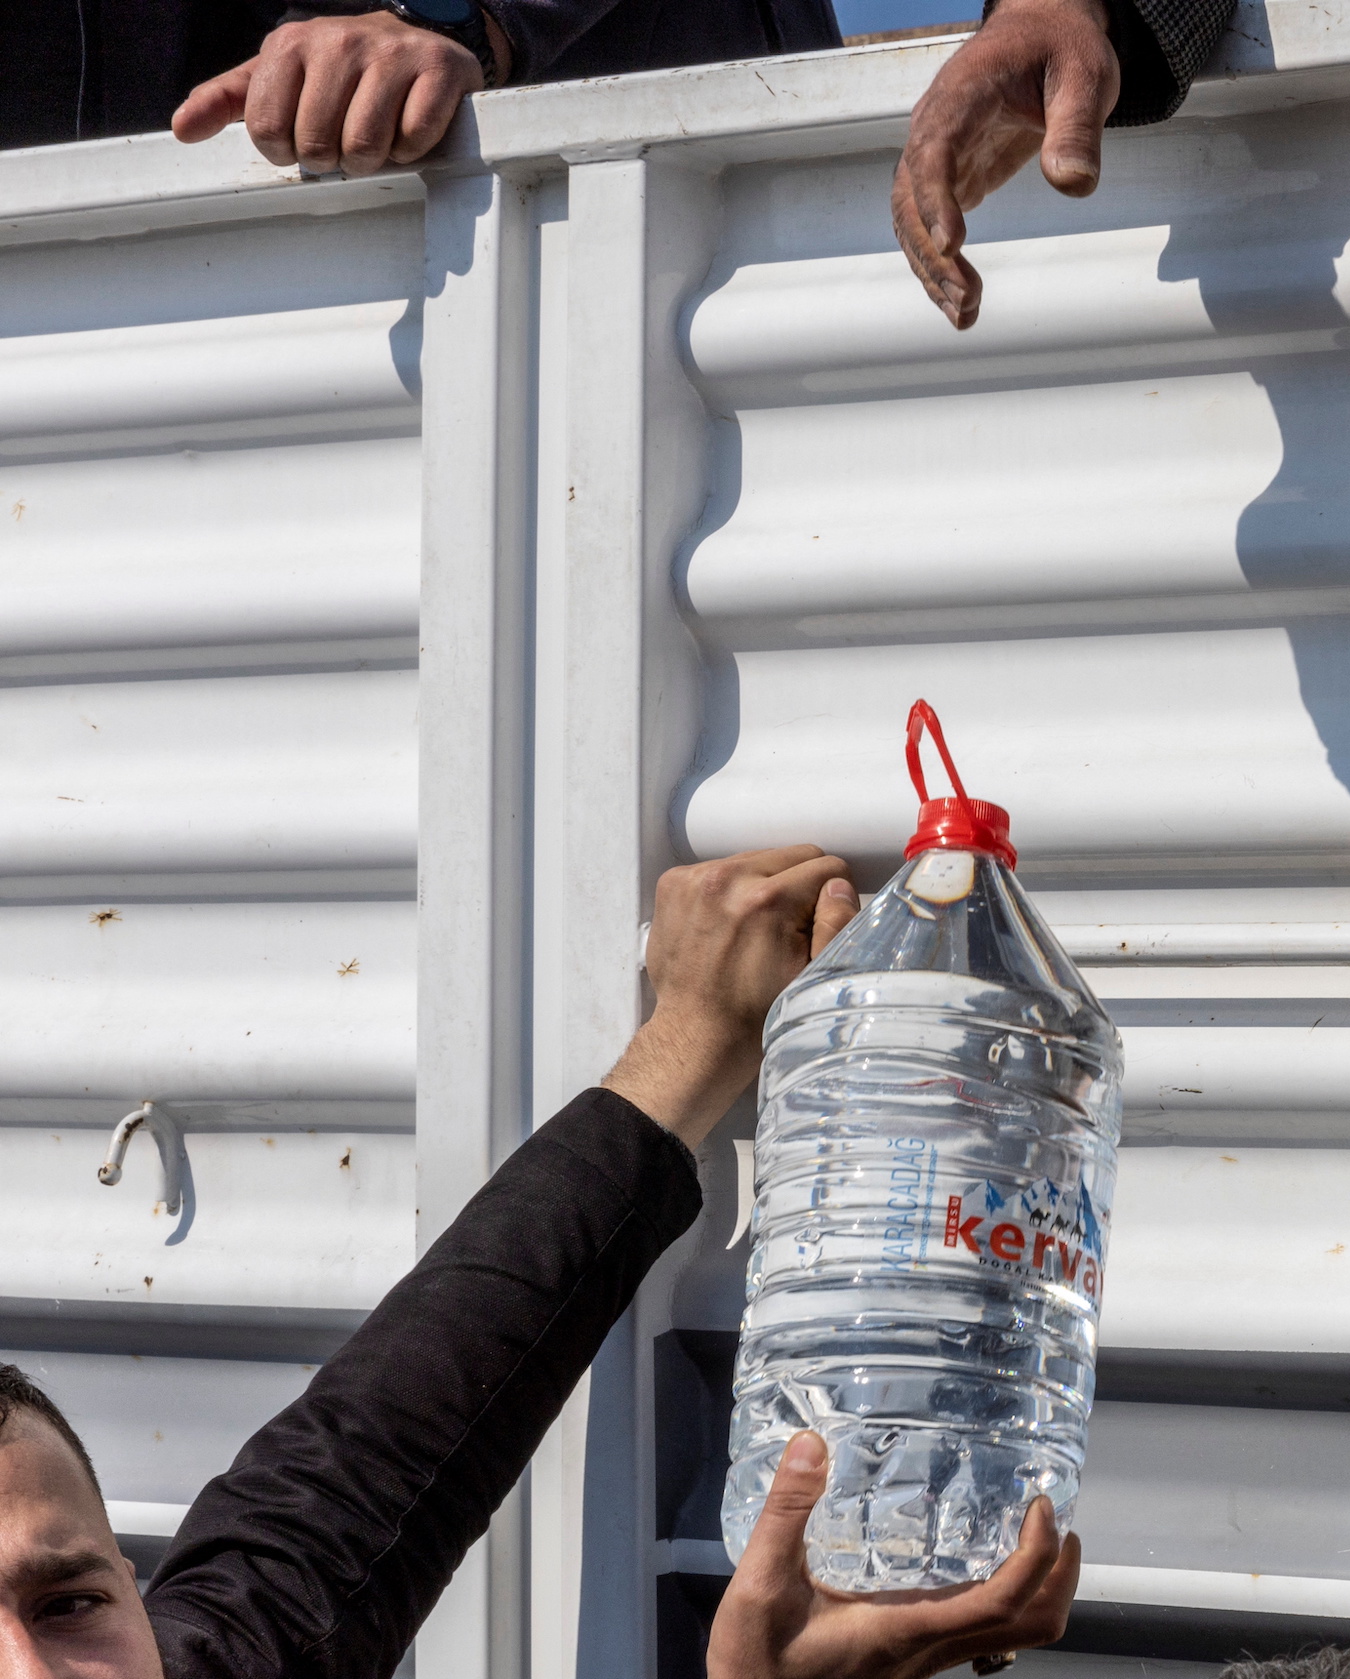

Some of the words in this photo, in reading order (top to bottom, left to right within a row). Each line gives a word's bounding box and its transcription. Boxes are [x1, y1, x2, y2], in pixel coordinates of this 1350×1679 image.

[880, 1137, 926, 1273] KARACADAĞ
[957, 1216, 1104, 1298] kerva
[979, 1256, 1030, 1276] DOĞAL
